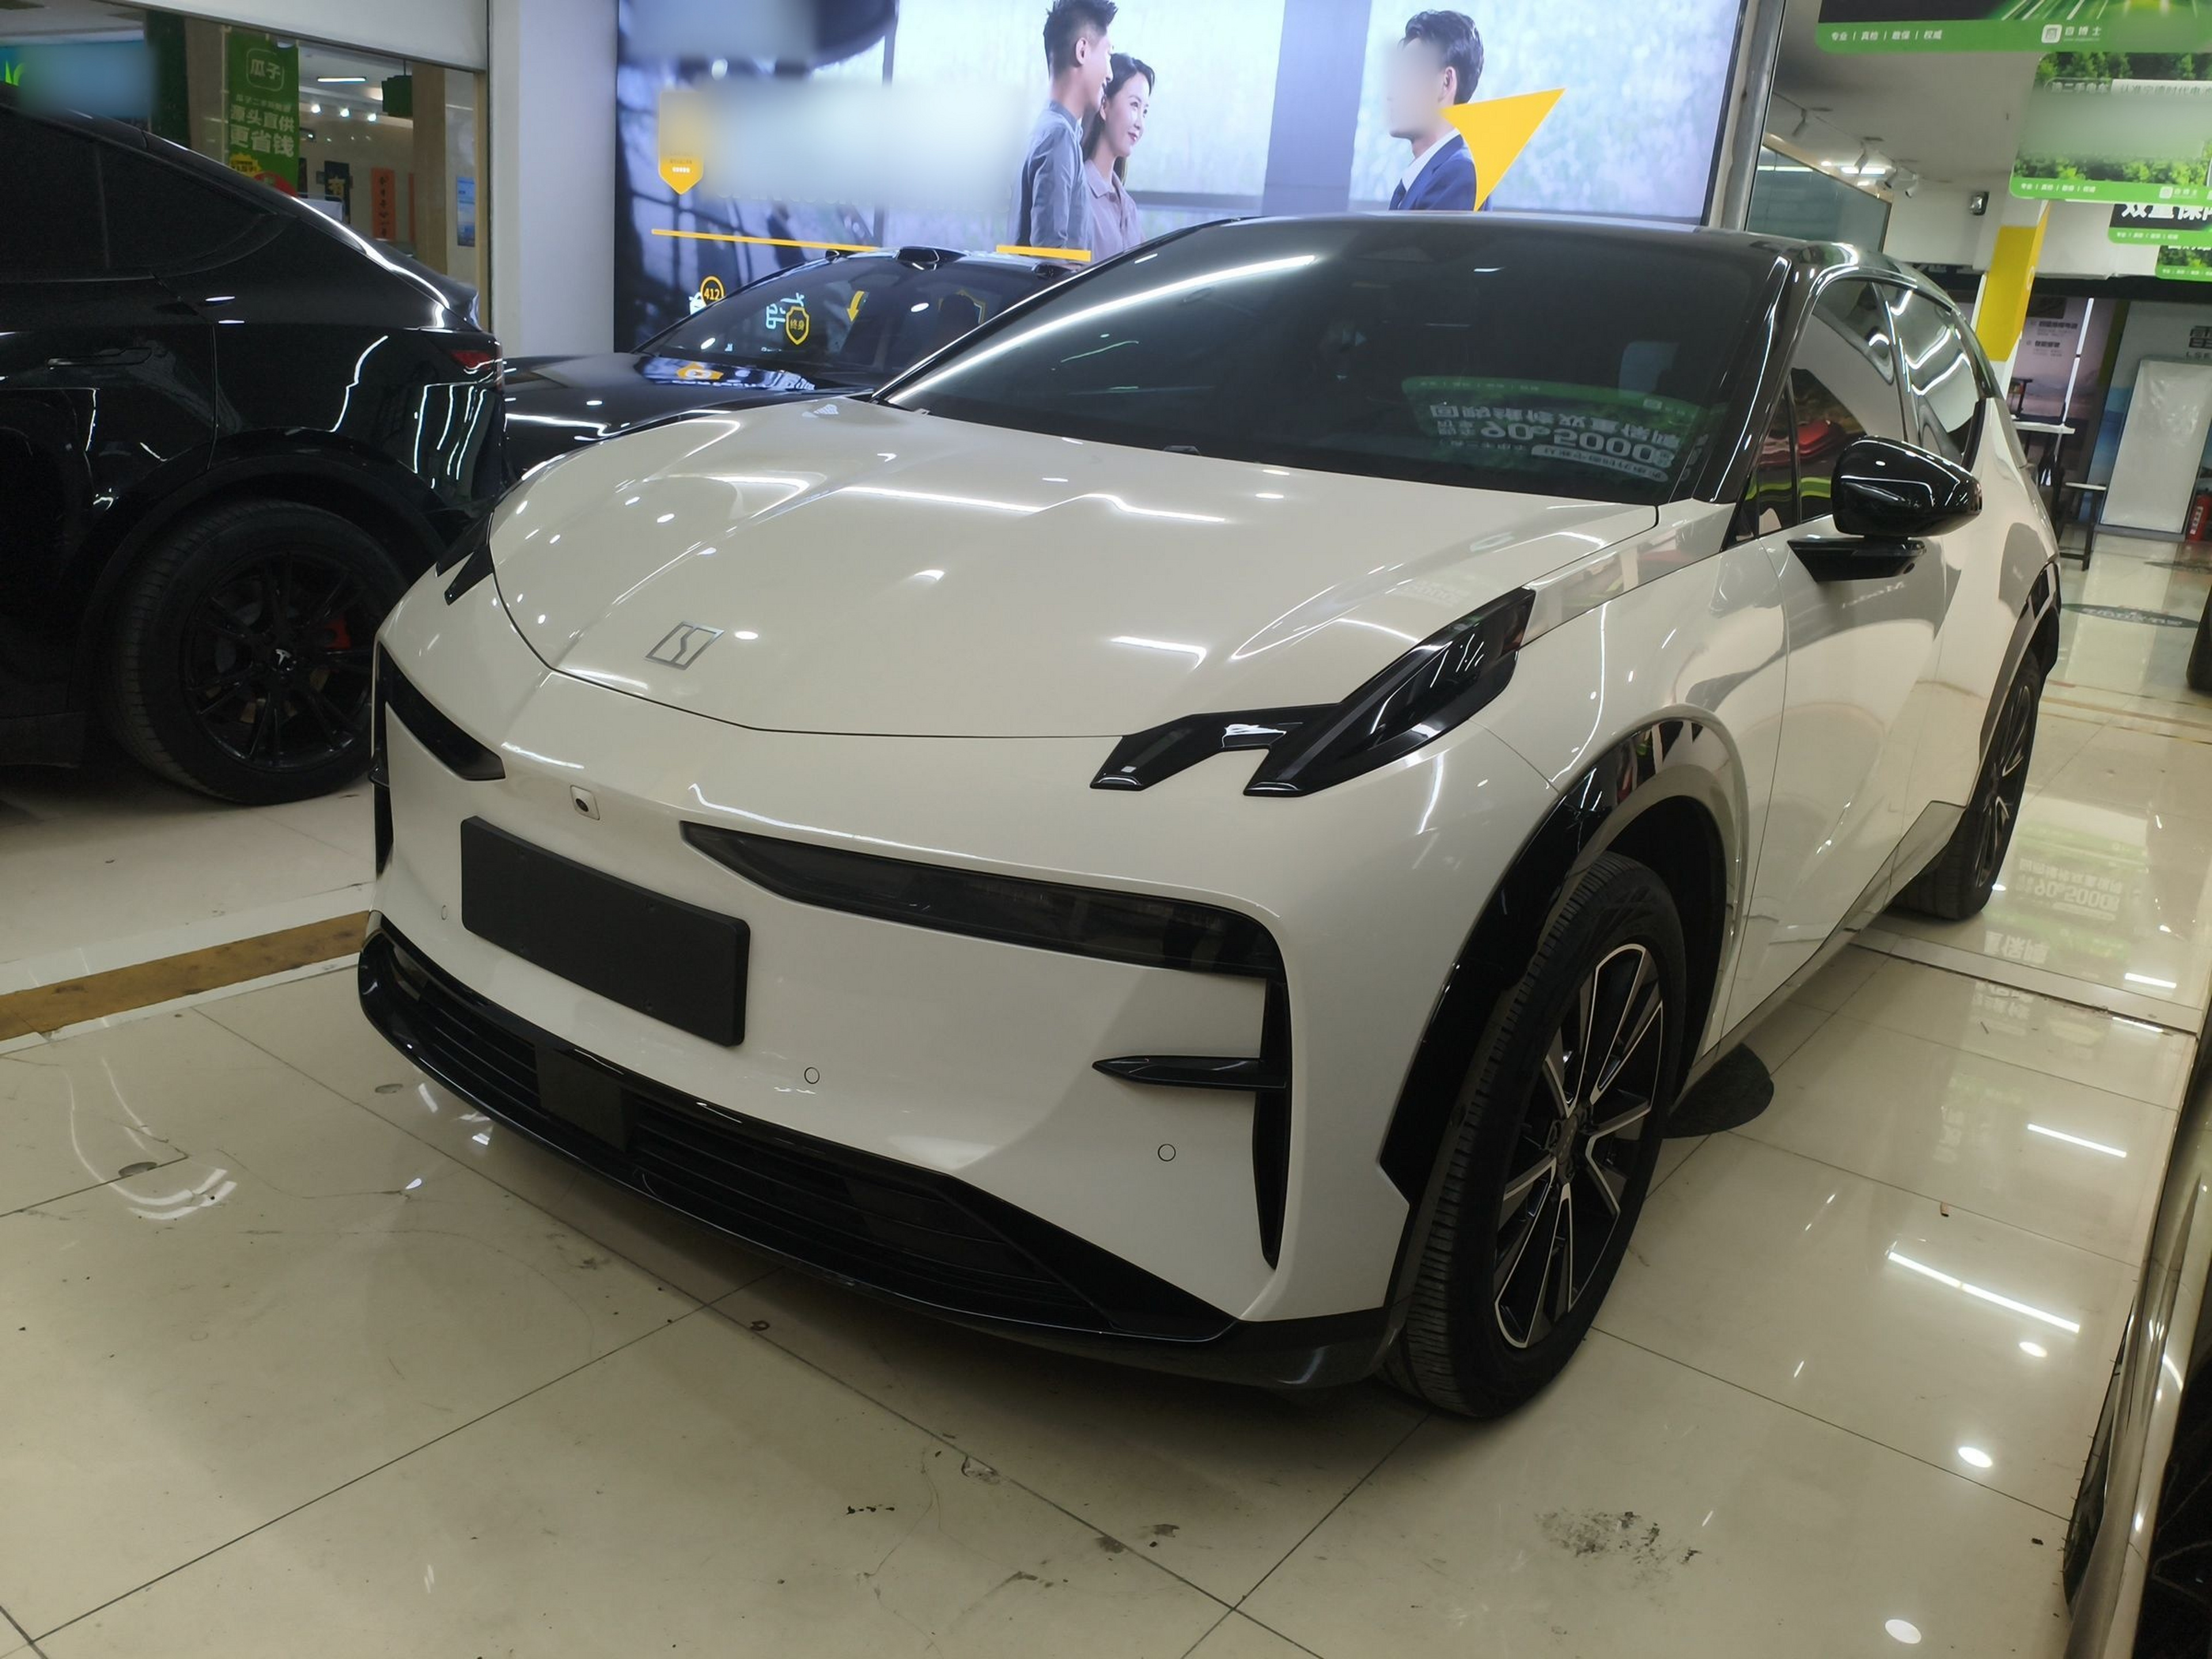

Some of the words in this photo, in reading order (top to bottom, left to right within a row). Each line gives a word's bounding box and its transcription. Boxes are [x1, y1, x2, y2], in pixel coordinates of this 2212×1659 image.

[249, 58, 281, 80] 瓜子
[230, 103, 295, 133] 源头直供
[230, 124, 295, 158] 更省钱
[703, 288, 720, 301] 412
